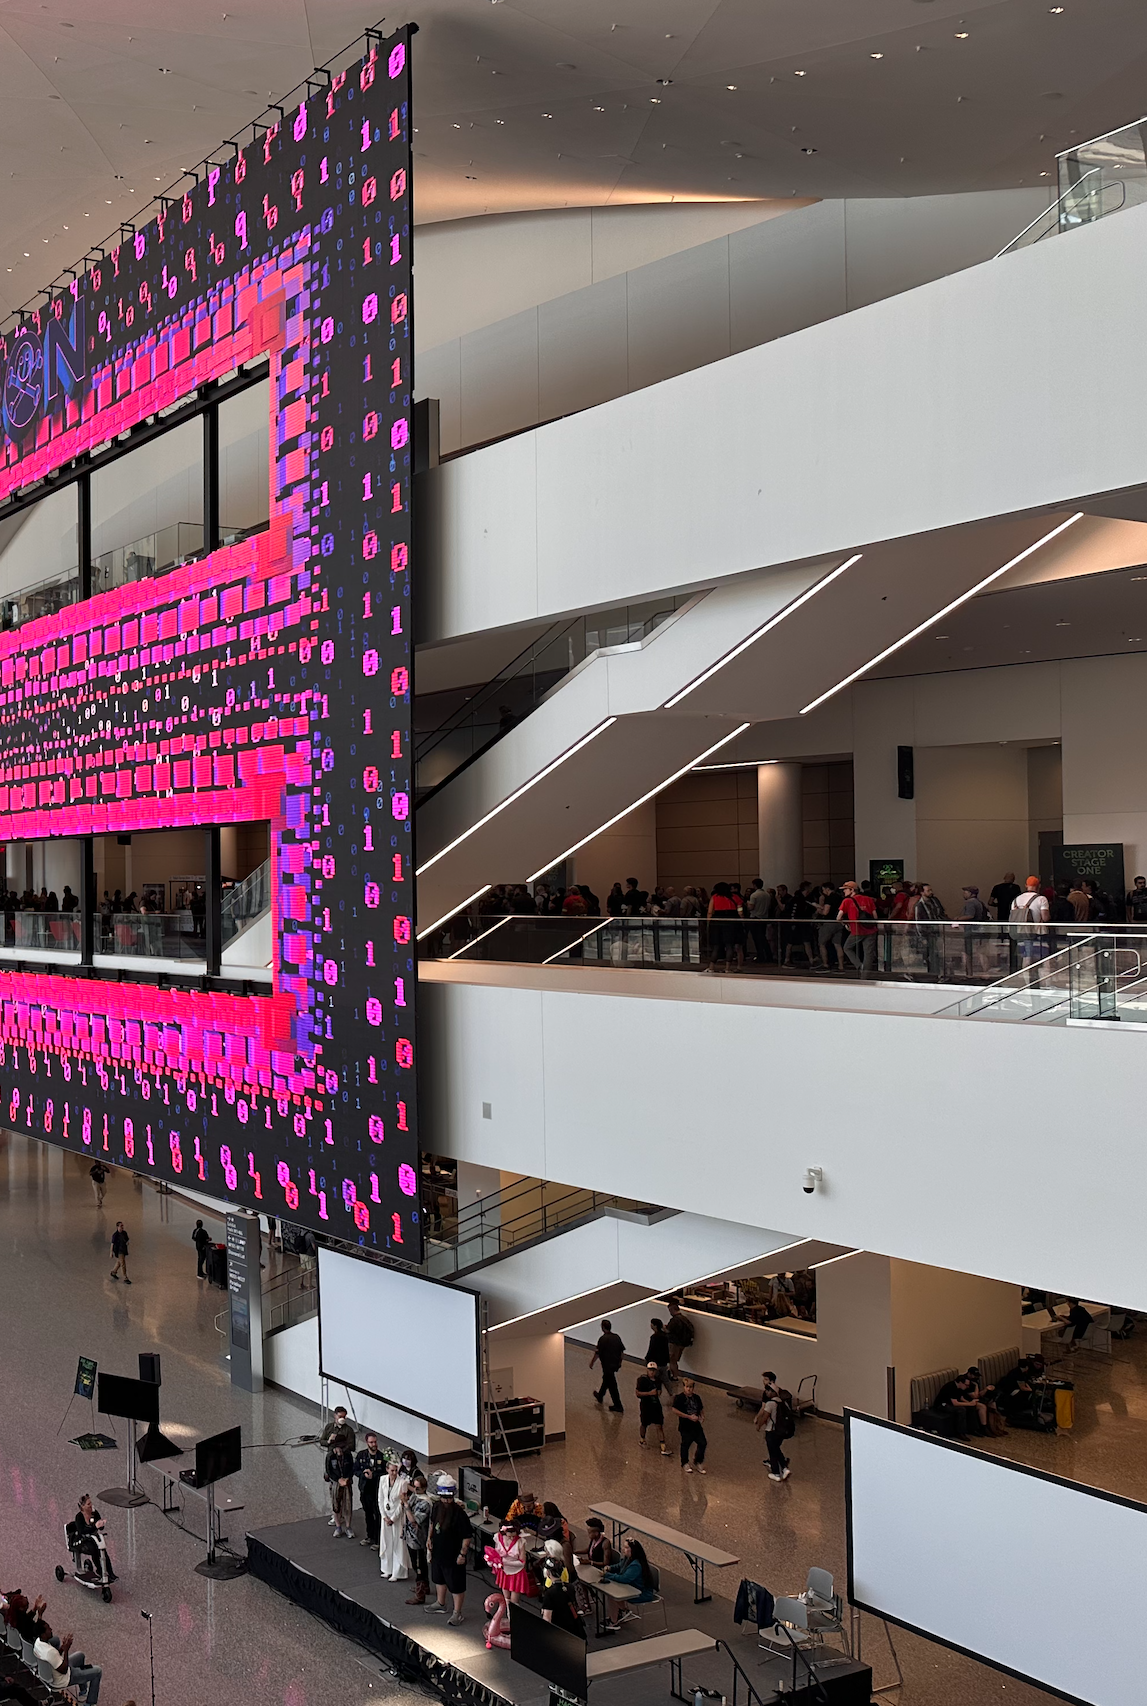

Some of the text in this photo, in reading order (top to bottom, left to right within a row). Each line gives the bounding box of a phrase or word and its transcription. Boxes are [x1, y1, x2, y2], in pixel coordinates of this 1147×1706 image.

[1063, 850, 1114, 859] CREATOR
[1071, 858, 1106, 867] STAGE
[1077, 866, 1101, 875] ONE
